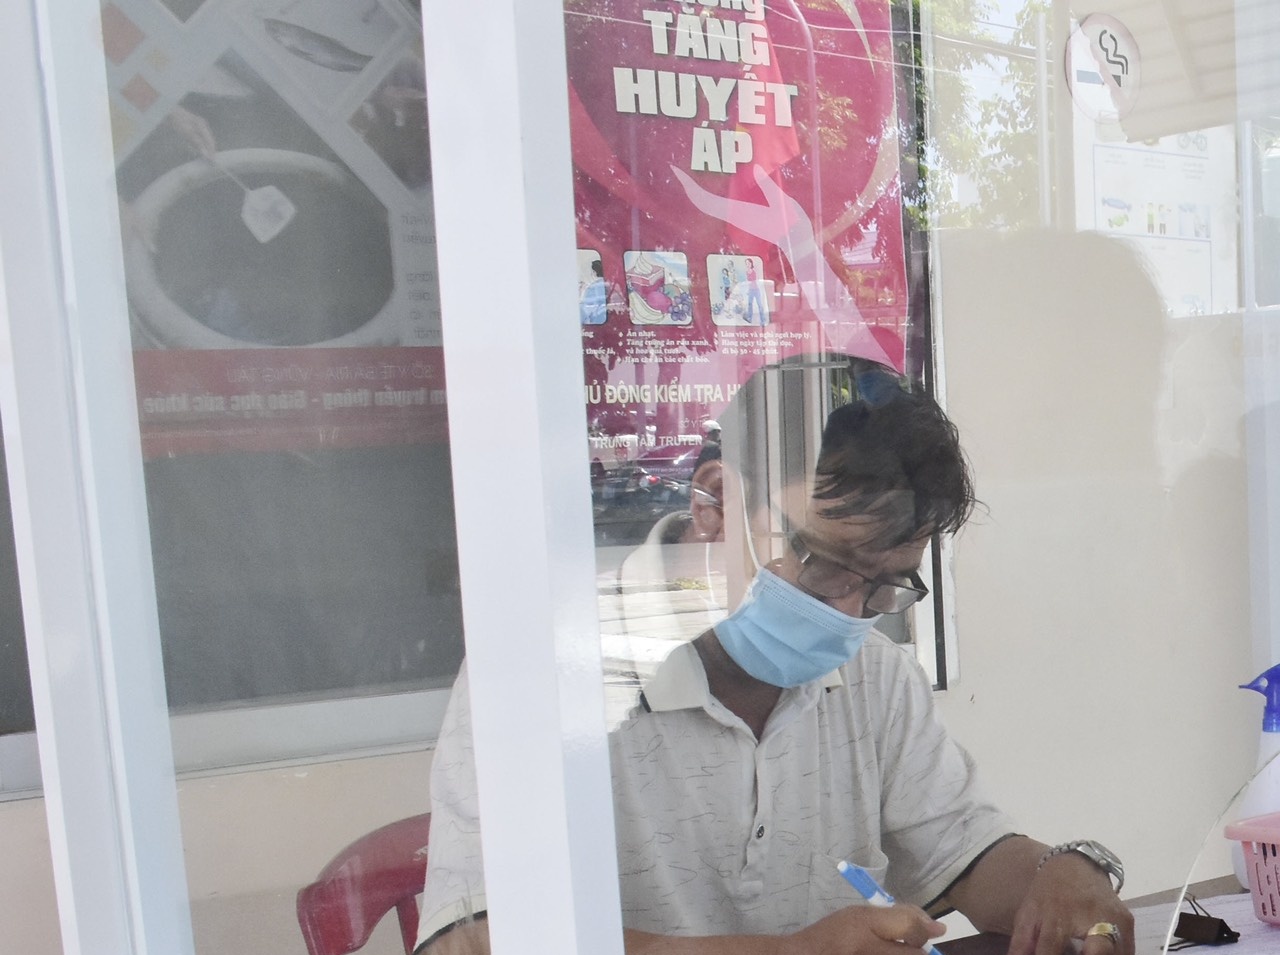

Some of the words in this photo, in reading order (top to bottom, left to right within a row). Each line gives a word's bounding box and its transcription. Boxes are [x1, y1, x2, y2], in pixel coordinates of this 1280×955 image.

[643, 5, 770, 66] TĂNG
[613, 65, 798, 127] HUYẾT
[691, 121, 752, 173] ÁP
[605, 380, 650, 408] ĐỘNG
[655, 377, 690, 403] KIỂM
